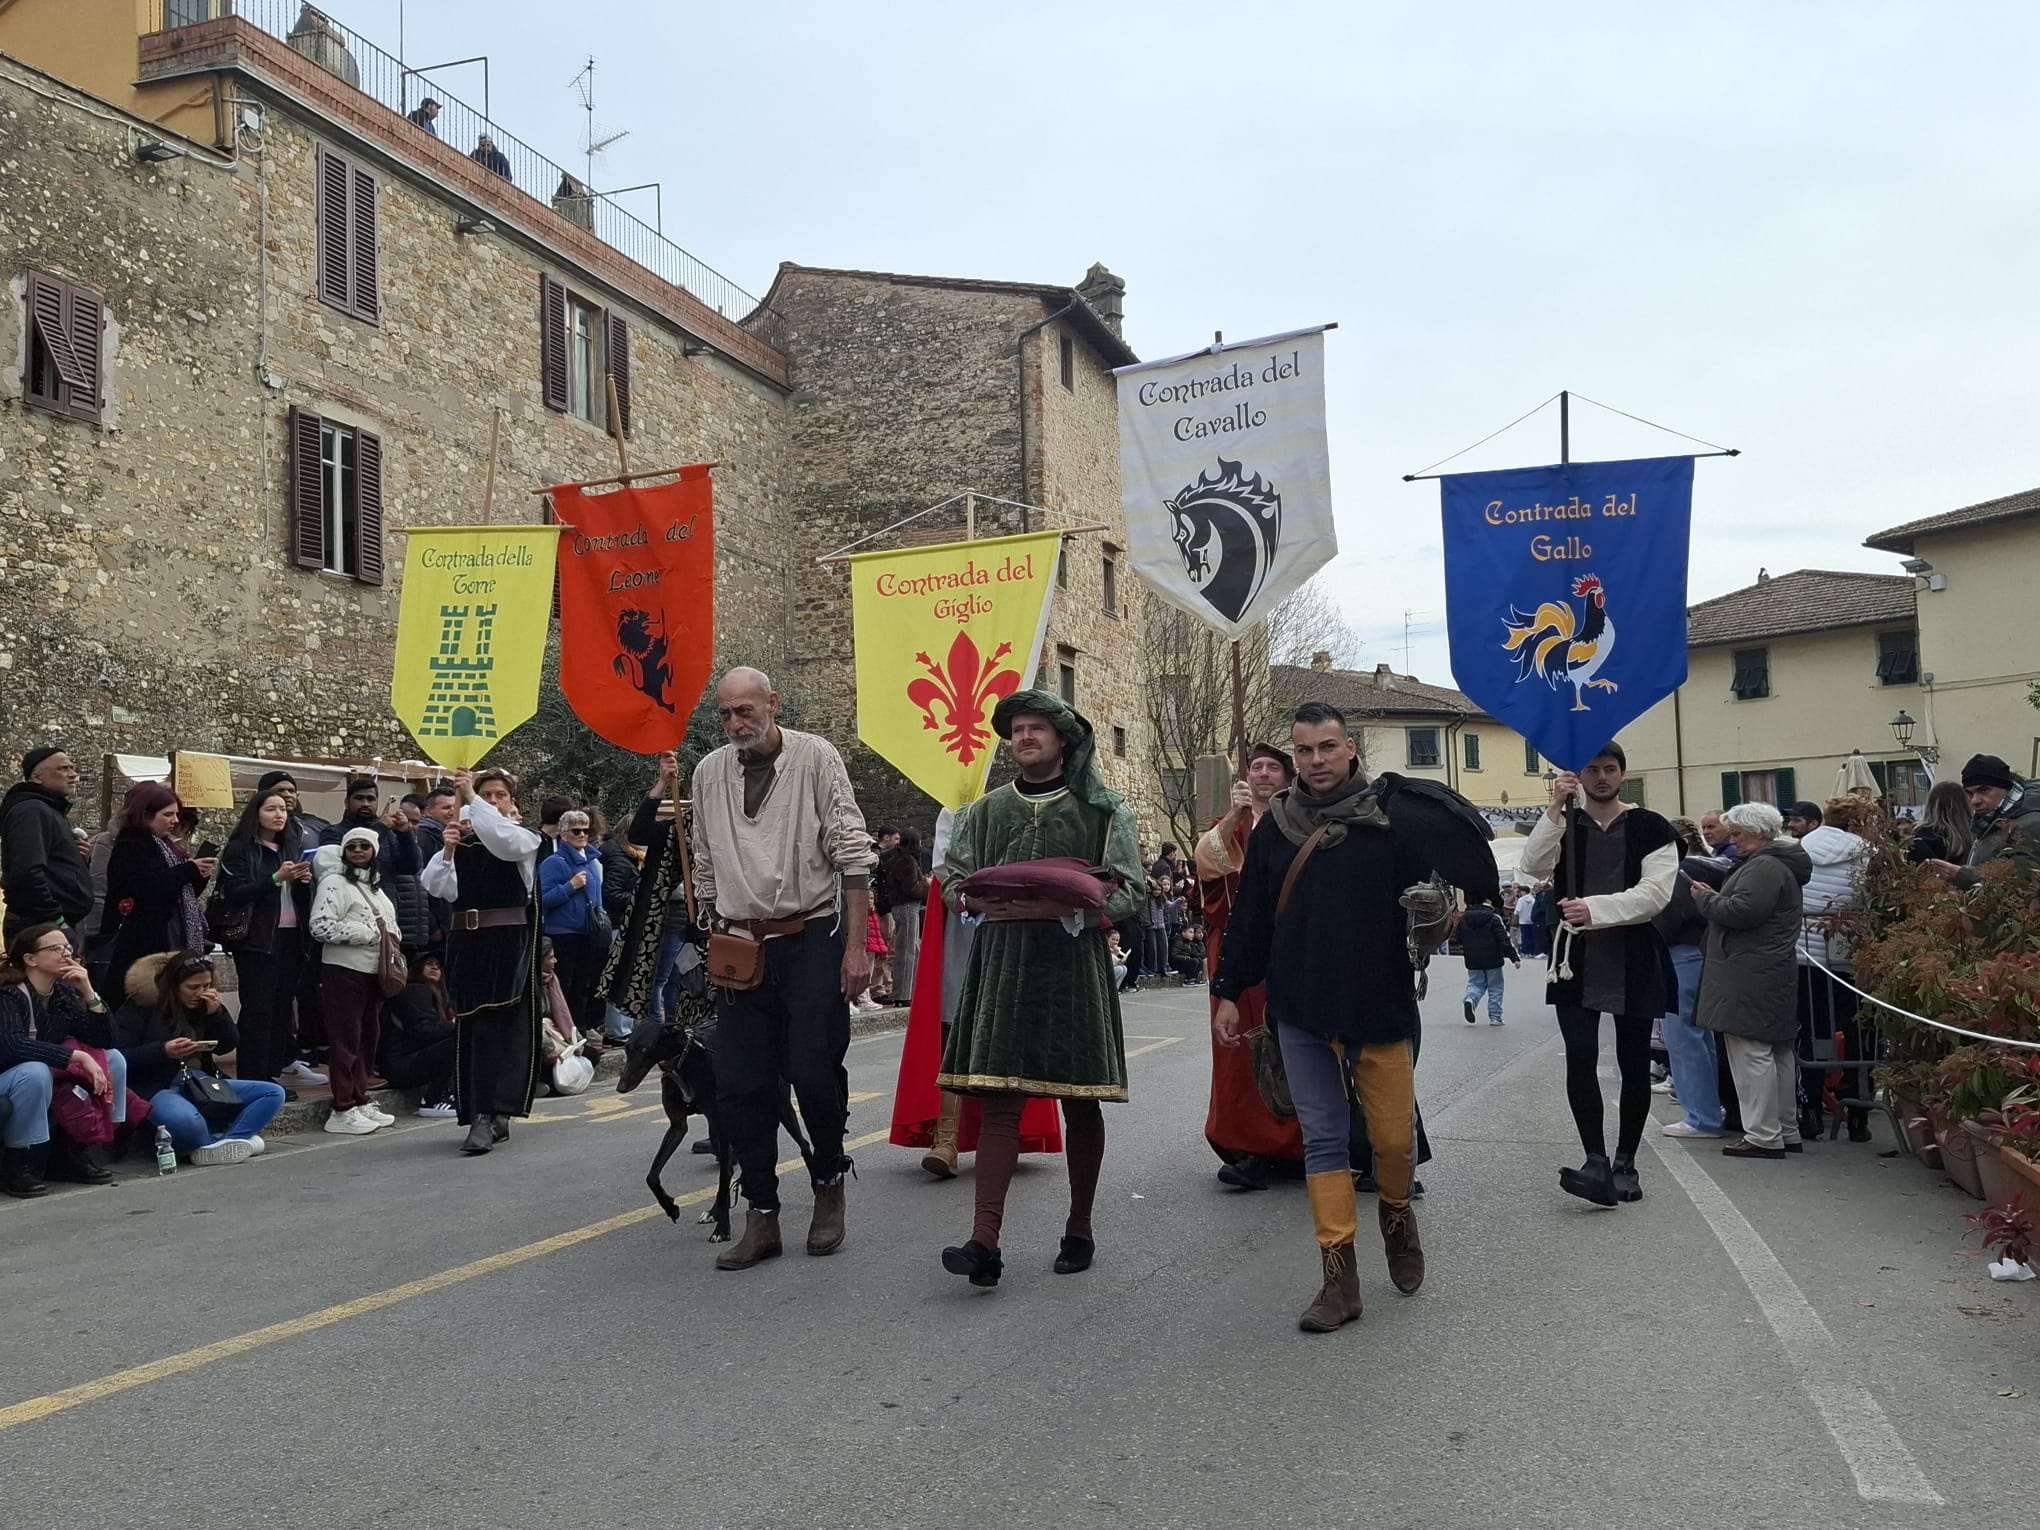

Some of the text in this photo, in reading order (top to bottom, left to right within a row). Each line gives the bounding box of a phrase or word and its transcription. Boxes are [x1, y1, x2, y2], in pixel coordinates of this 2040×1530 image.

[1139, 350, 1301, 407] Contrada del
[1173, 402, 1267, 441] Cavallo
[1485, 493, 1636, 525] Contrada del
[574, 514, 697, 556] Contrada del
[1530, 534, 1592, 561] Gallo
[421, 545, 533, 570] Contrada della
[452, 574, 497, 594] Torre
[608, 570, 661, 592] Leone
[876, 553, 1034, 597] Contrada del
[933, 593, 993, 624] Giglio
[1483, 806, 1548, 815] CONTRA
